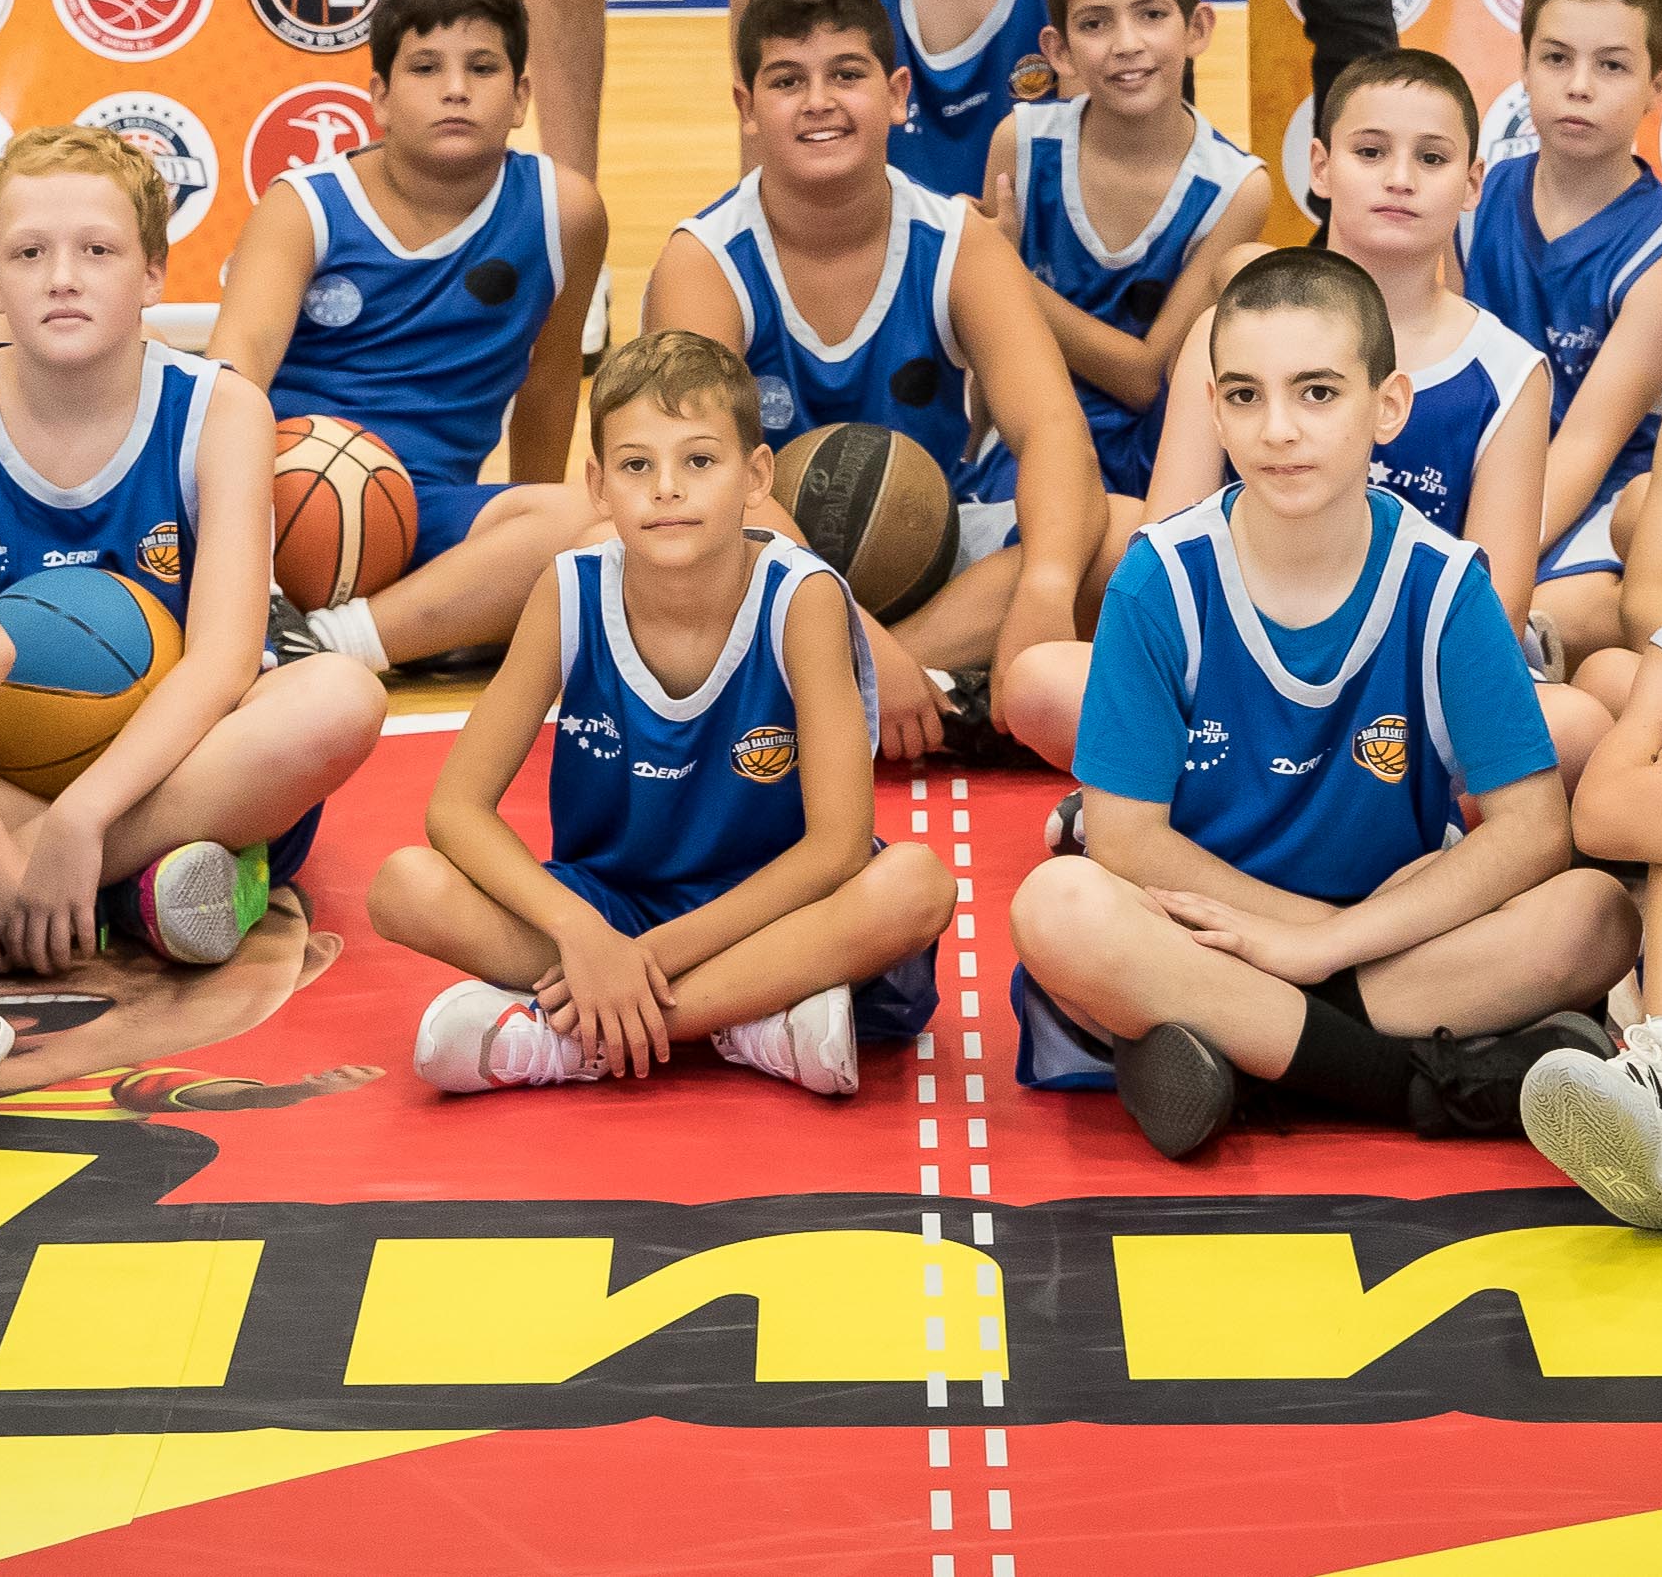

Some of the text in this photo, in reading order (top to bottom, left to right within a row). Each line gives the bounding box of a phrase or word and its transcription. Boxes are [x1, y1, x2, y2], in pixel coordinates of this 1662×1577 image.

[1203, 719, 1222, 733] בני
[751, 734, 795, 748] BASKETBALL
[632, 759, 697, 781] DERBY
